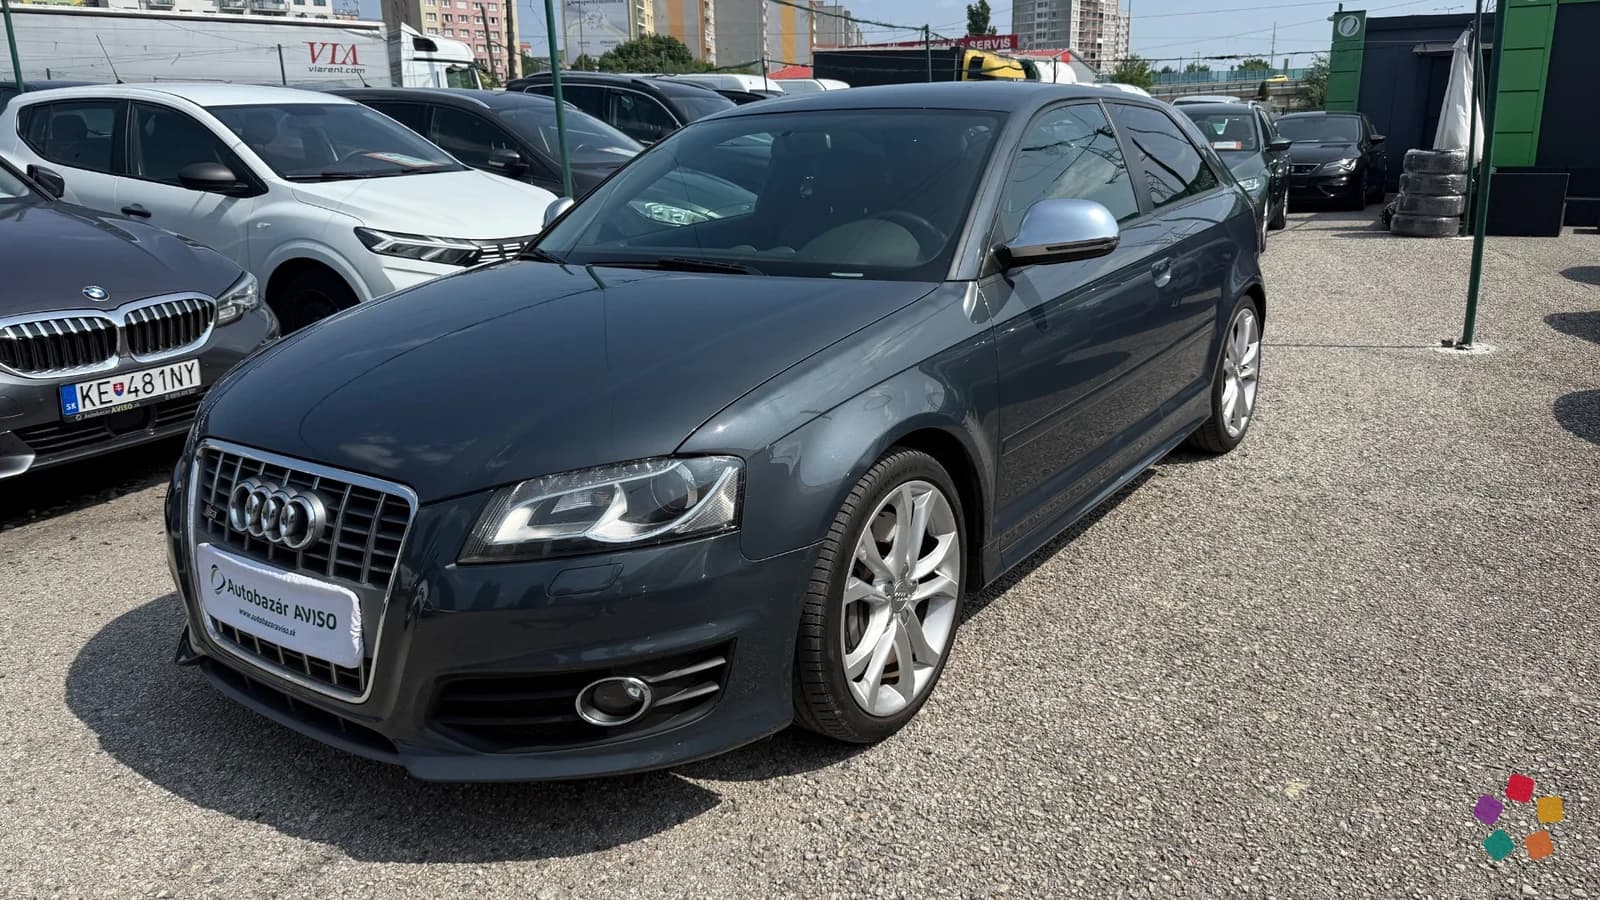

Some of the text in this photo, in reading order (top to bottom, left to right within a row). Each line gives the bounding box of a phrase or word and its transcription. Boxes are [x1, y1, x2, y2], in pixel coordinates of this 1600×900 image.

[302, 41, 366, 65] VIA
[969, 37, 1011, 50] SERVIS
[308, 65, 366, 74] viarent.com
[80, 381, 112, 409] KE
[127, 362, 196, 398] 481NY
[66, 402, 77, 411] SK
[227, 579, 337, 630] Autobazár AVISO
[238, 608, 296, 637] www.autobazaraviso.sk
